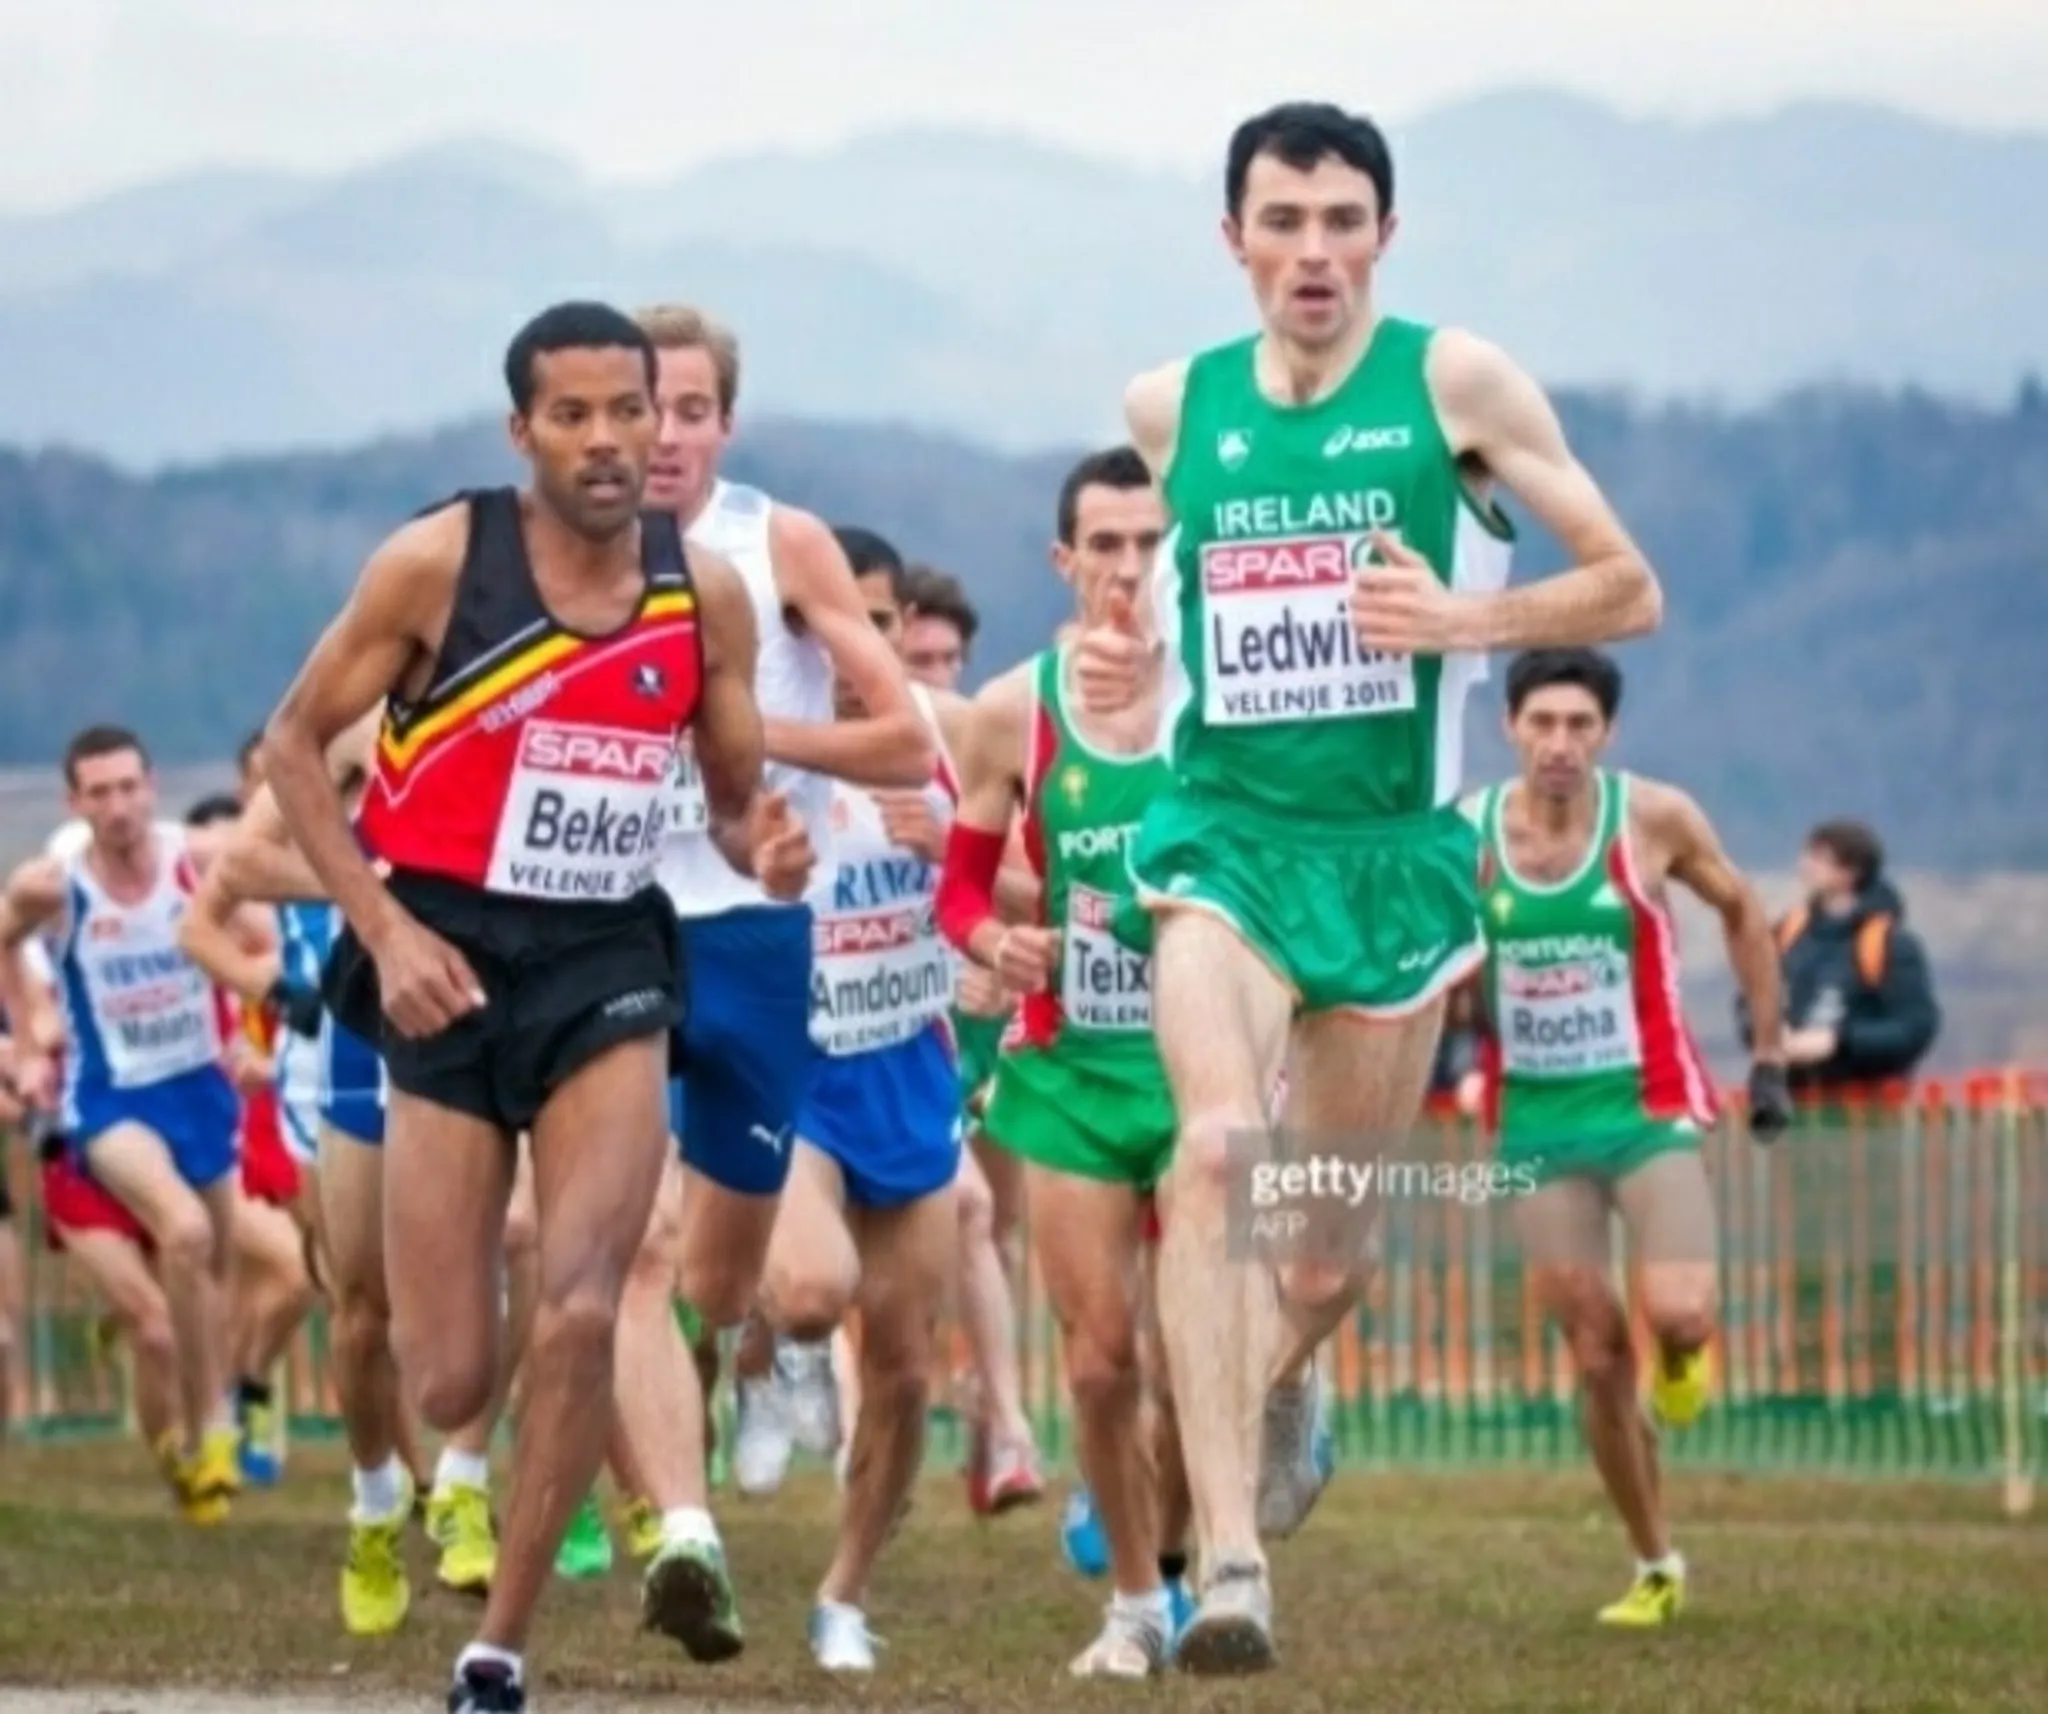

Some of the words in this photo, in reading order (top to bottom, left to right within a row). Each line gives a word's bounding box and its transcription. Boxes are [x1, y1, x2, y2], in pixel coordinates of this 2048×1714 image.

[1213, 489, 1396, 536] IRELAND
[1207, 543, 1343, 588] SPAR
[1213, 601, 1402, 676] Ledwi
[1222, 685, 1331, 715] VELENJE
[1342, 680, 1399, 706] 2011
[527, 731, 666, 775] SPAR
[510, 862, 616, 895] VELENJE
[811, 947, 948, 1017] Amdouni
[1073, 937, 1149, 995] Teix
[1513, 1005, 1616, 1046] Rocha
